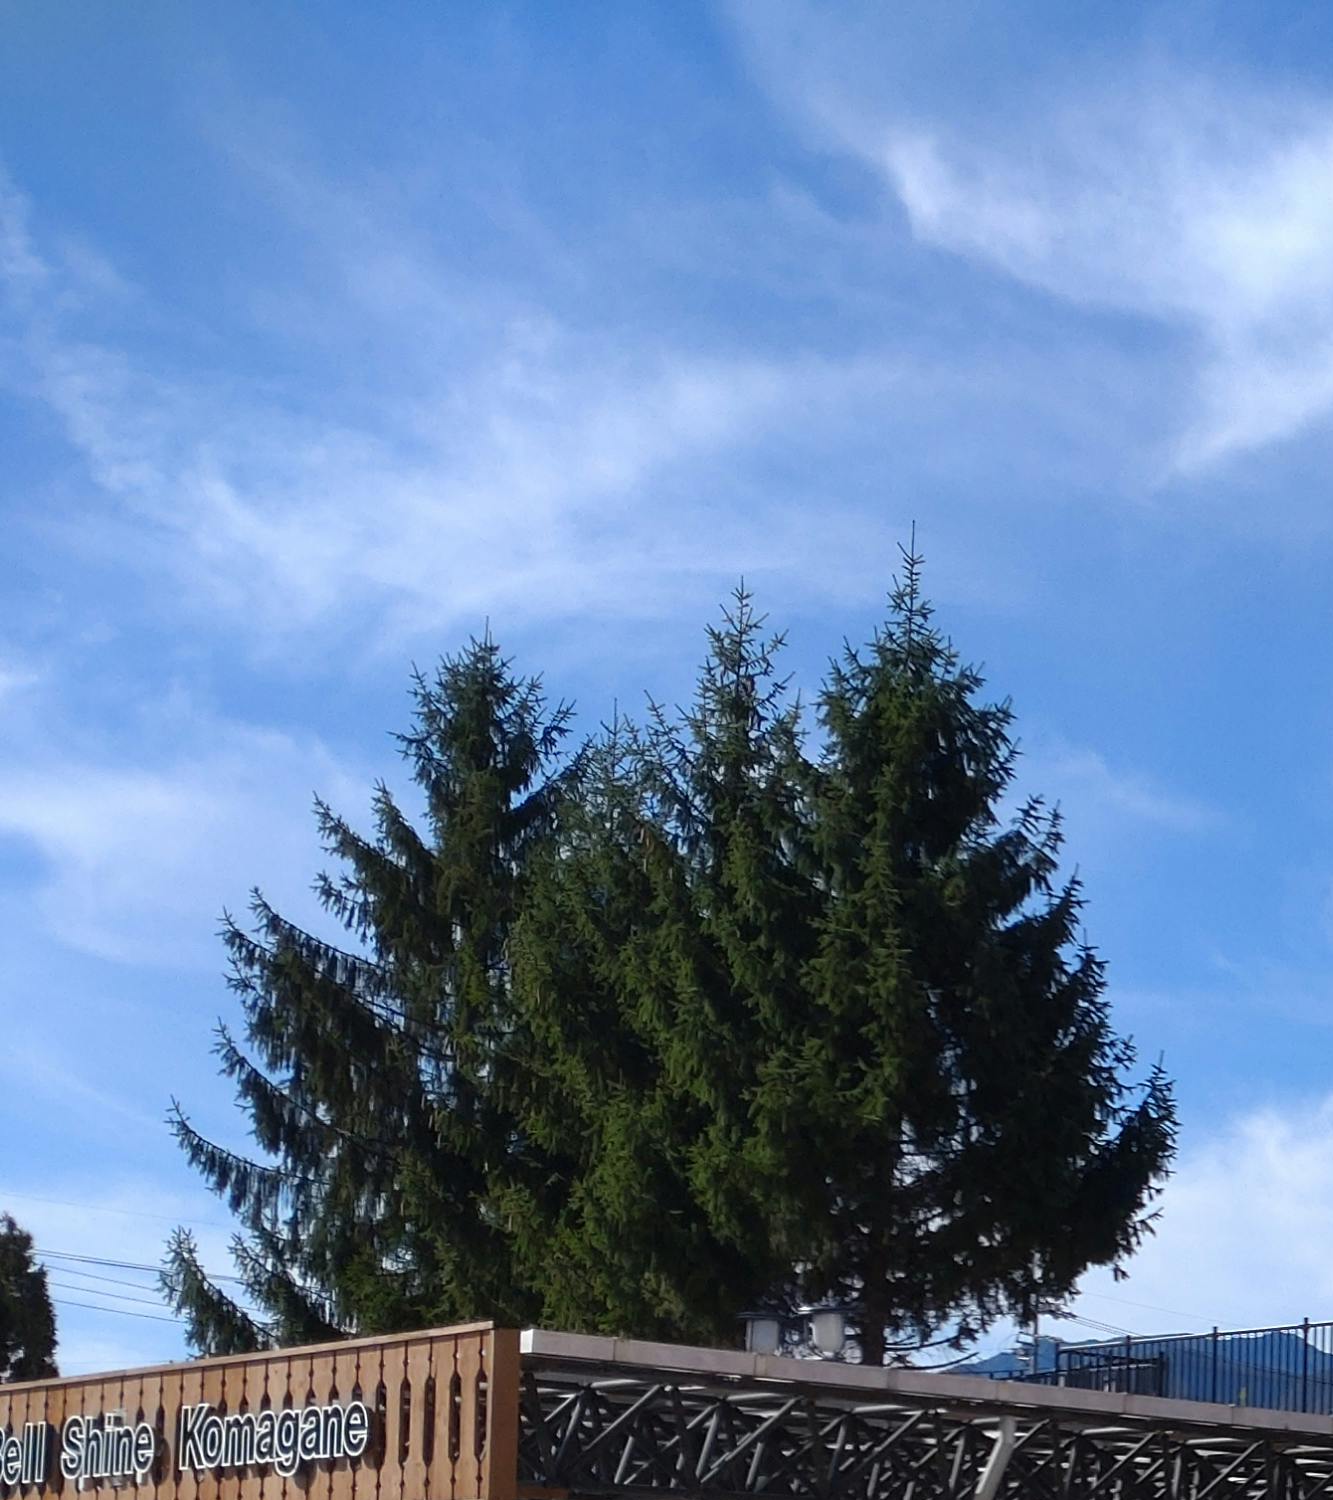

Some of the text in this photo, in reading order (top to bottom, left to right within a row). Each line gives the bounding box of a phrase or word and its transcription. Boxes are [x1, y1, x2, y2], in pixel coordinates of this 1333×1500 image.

[0, 1402, 369, 1485] ell Shine Komagane
